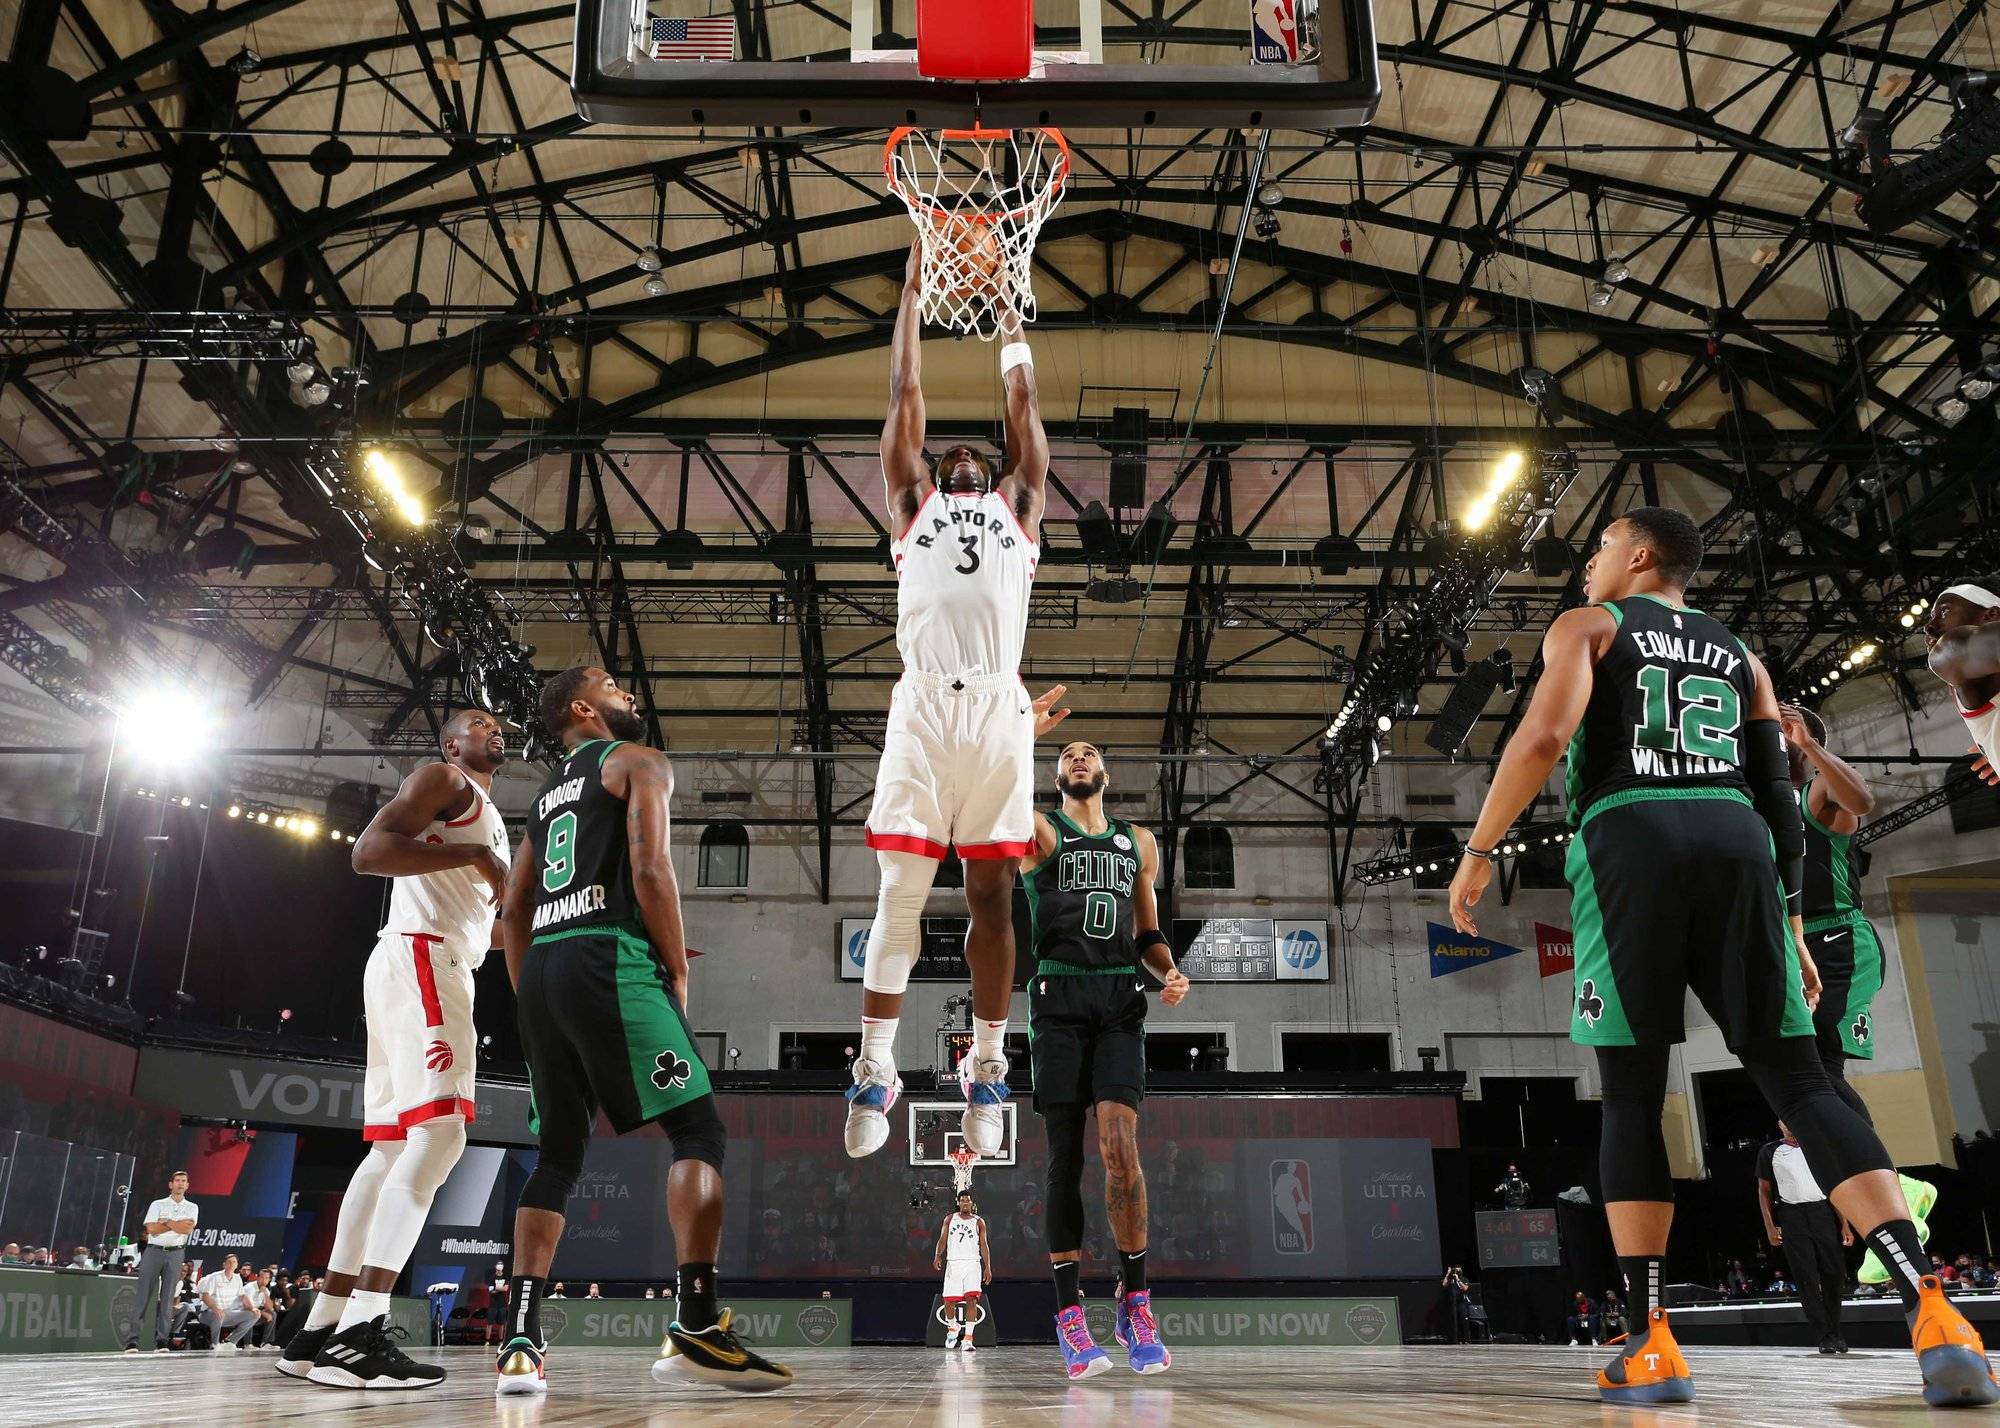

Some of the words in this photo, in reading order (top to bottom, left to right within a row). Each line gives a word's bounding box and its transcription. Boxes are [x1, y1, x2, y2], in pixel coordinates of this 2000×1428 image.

[1260, 46, 1281, 59] NBA
[916, 509, 1016, 550] RAPTORS
[955, 535, 980, 575] 3
[1631, 630, 1741, 676] EQUALITY
[1633, 664, 1741, 767] 12
[539, 777, 586, 822] ENOUGH
[543, 810, 578, 893] 9
[1058, 850, 1137, 898] CELTICS
[531, 884, 606, 932] ANAMAKER
[1083, 891, 1117, 940] 0
[1286, 930, 1318, 969] hp
[1434, 943, 1490, 957] Alamo
[952, 1036, 976, 1047] 4:4
[1363, 1184, 1426, 1198] ULTRA
[958, 1232, 965, 1243] 7
[1529, 1220, 1545, 1232] 65
[218, 1230, 256, 1247] Season
[440, 1238, 510, 1254] #WholeNewGame
[1279, 1232, 1300, 1248] NBA
[1485, 1248, 1494, 1260] 3
[1531, 1247, 1548, 1260] 64
[582, 1313, 653, 1337] SIGN
[732, 1313, 782, 1337] OW
[1154, 1313, 1206, 1337] IGN
[1213, 1313, 1250, 1337] UP
[1258, 1313, 1330, 1337] NOW
[1644, 1353, 1660, 1371] T
